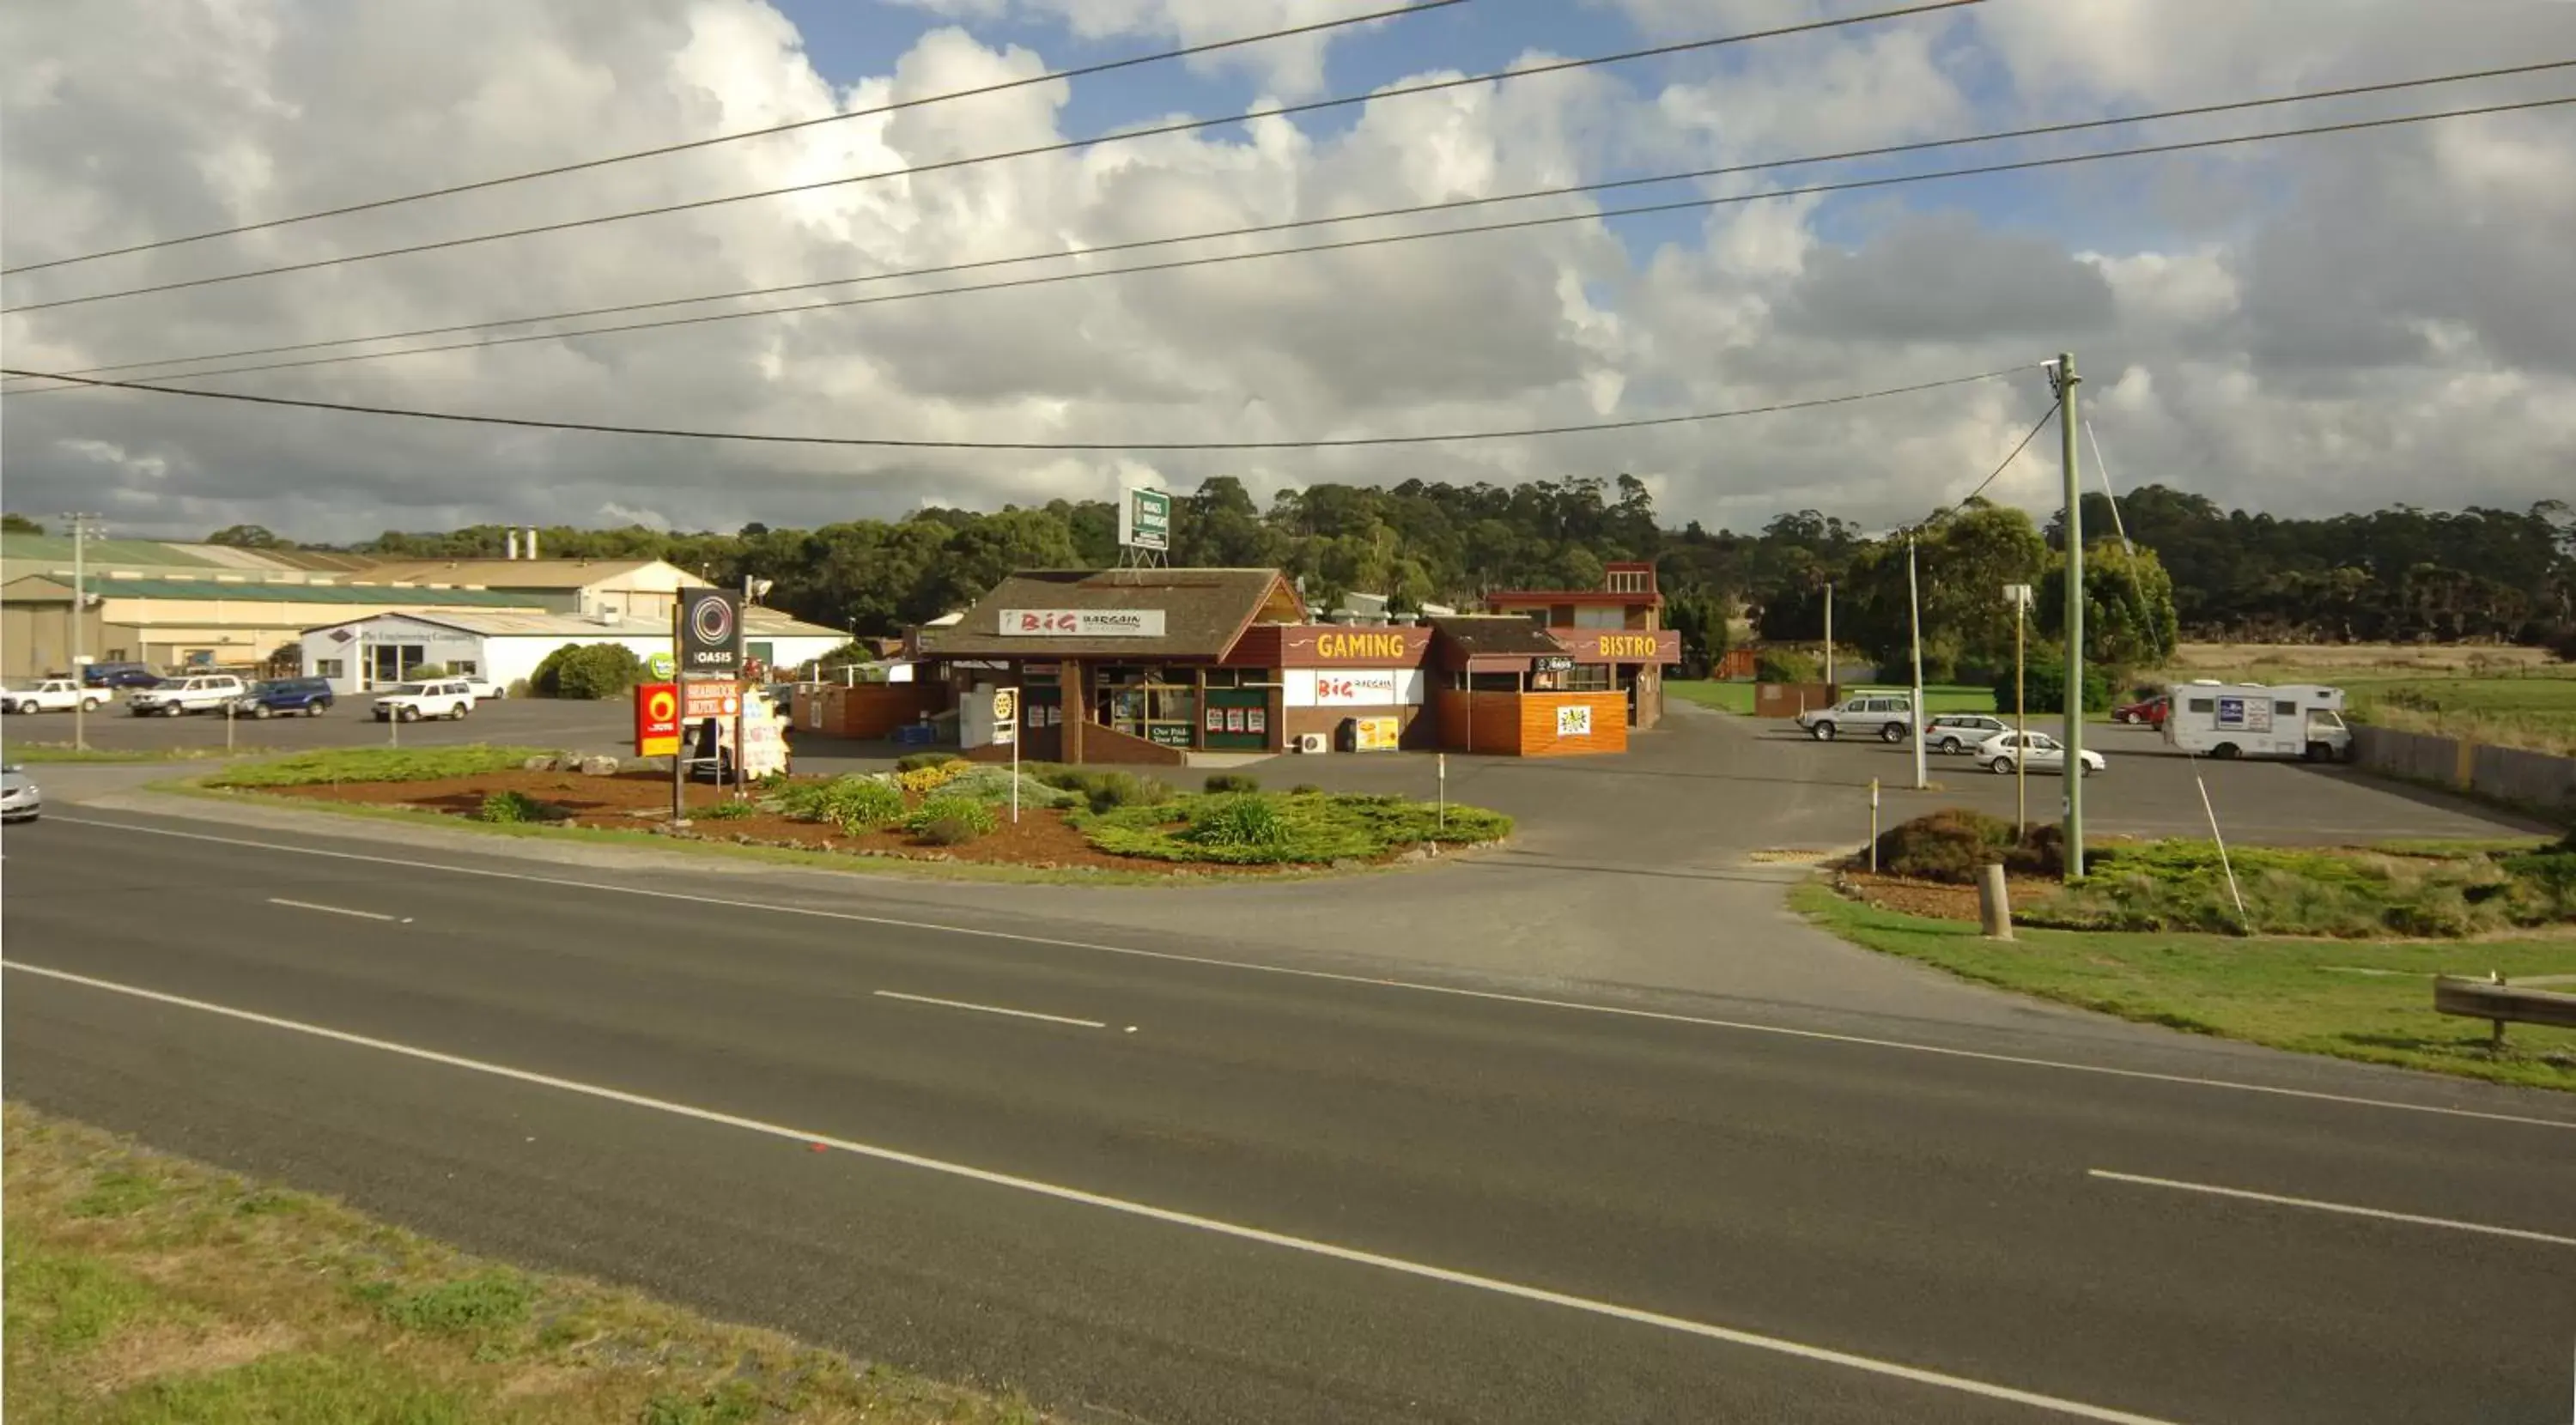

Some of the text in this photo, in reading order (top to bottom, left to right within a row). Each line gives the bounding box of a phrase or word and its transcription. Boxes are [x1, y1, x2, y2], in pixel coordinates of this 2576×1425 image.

[1317, 634, 1405, 658] GAMING
[1600, 635, 1656, 657] BISTRO
[698, 652, 732, 663] OASIS
